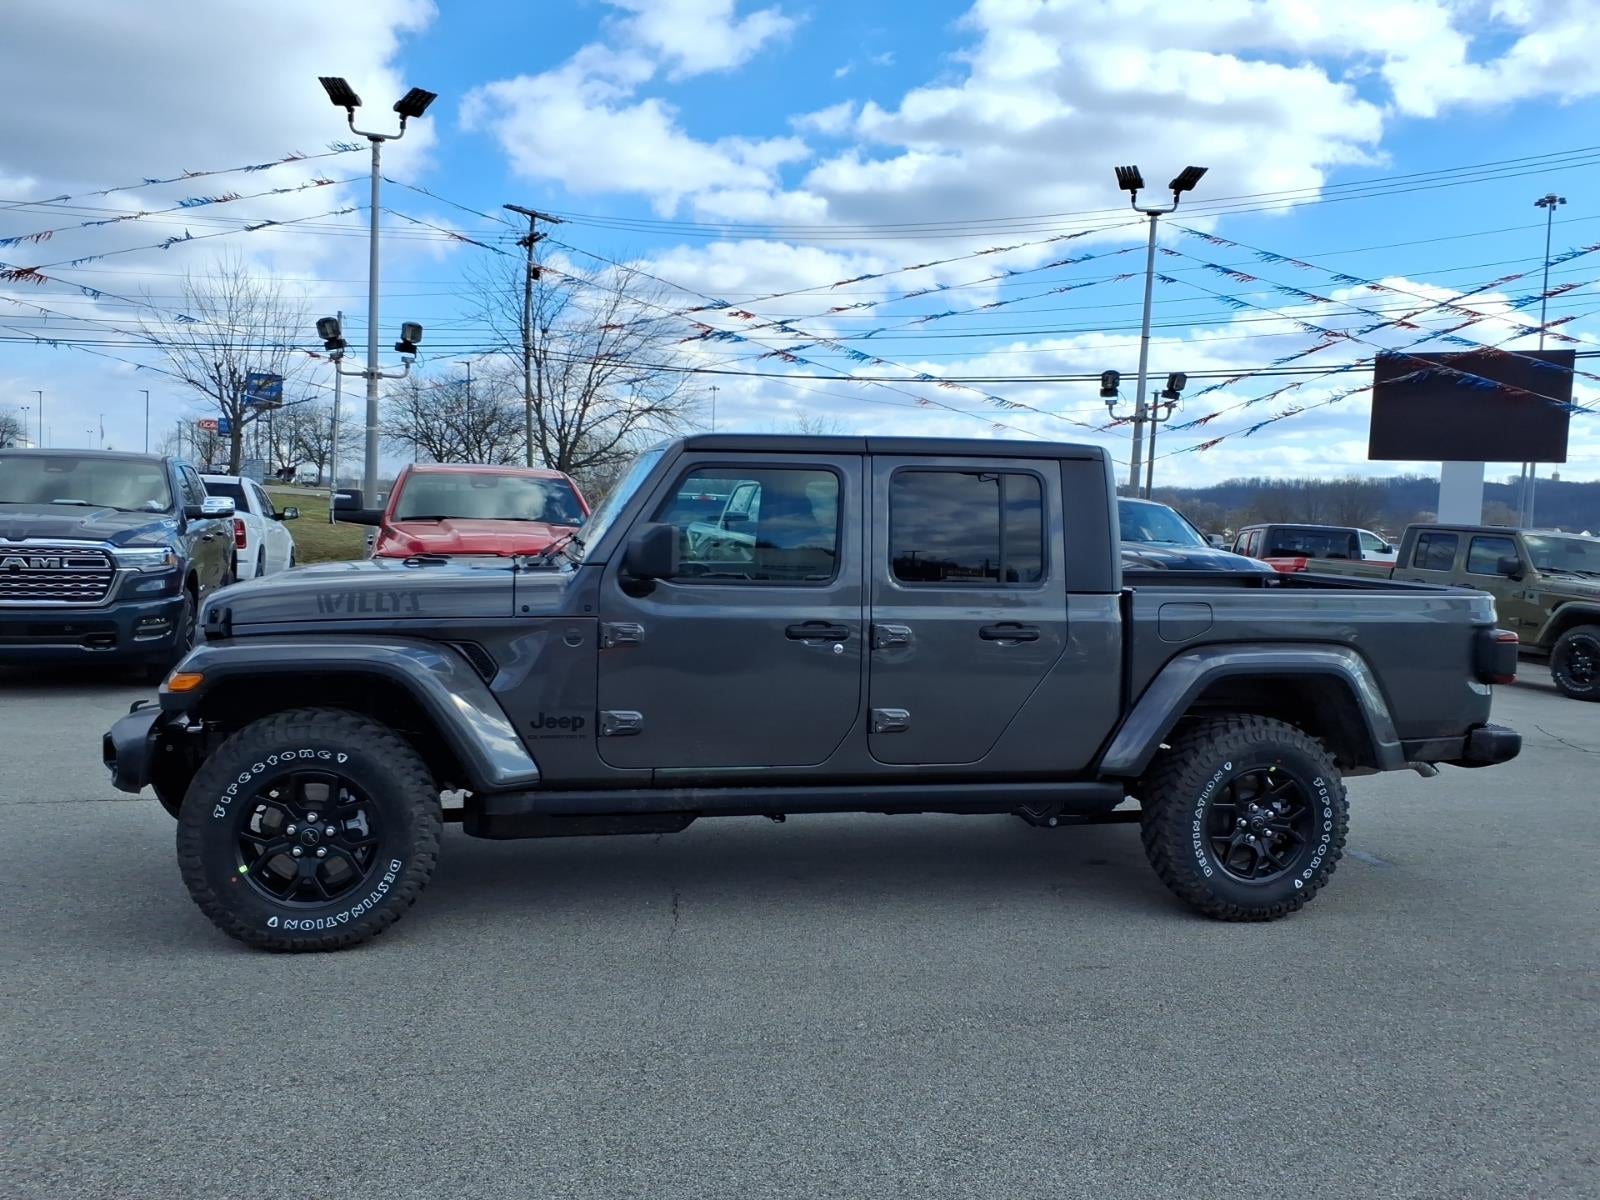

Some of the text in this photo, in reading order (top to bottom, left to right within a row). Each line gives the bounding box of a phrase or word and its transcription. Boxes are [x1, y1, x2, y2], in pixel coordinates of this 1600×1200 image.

[0, 557, 60, 568] AM
[315, 591, 424, 614] WILLYS
[530, 711, 585, 732] Jeep
[1192, 769, 1224, 878] DESTINATION
[283, 858, 402, 931] DESTINATION
